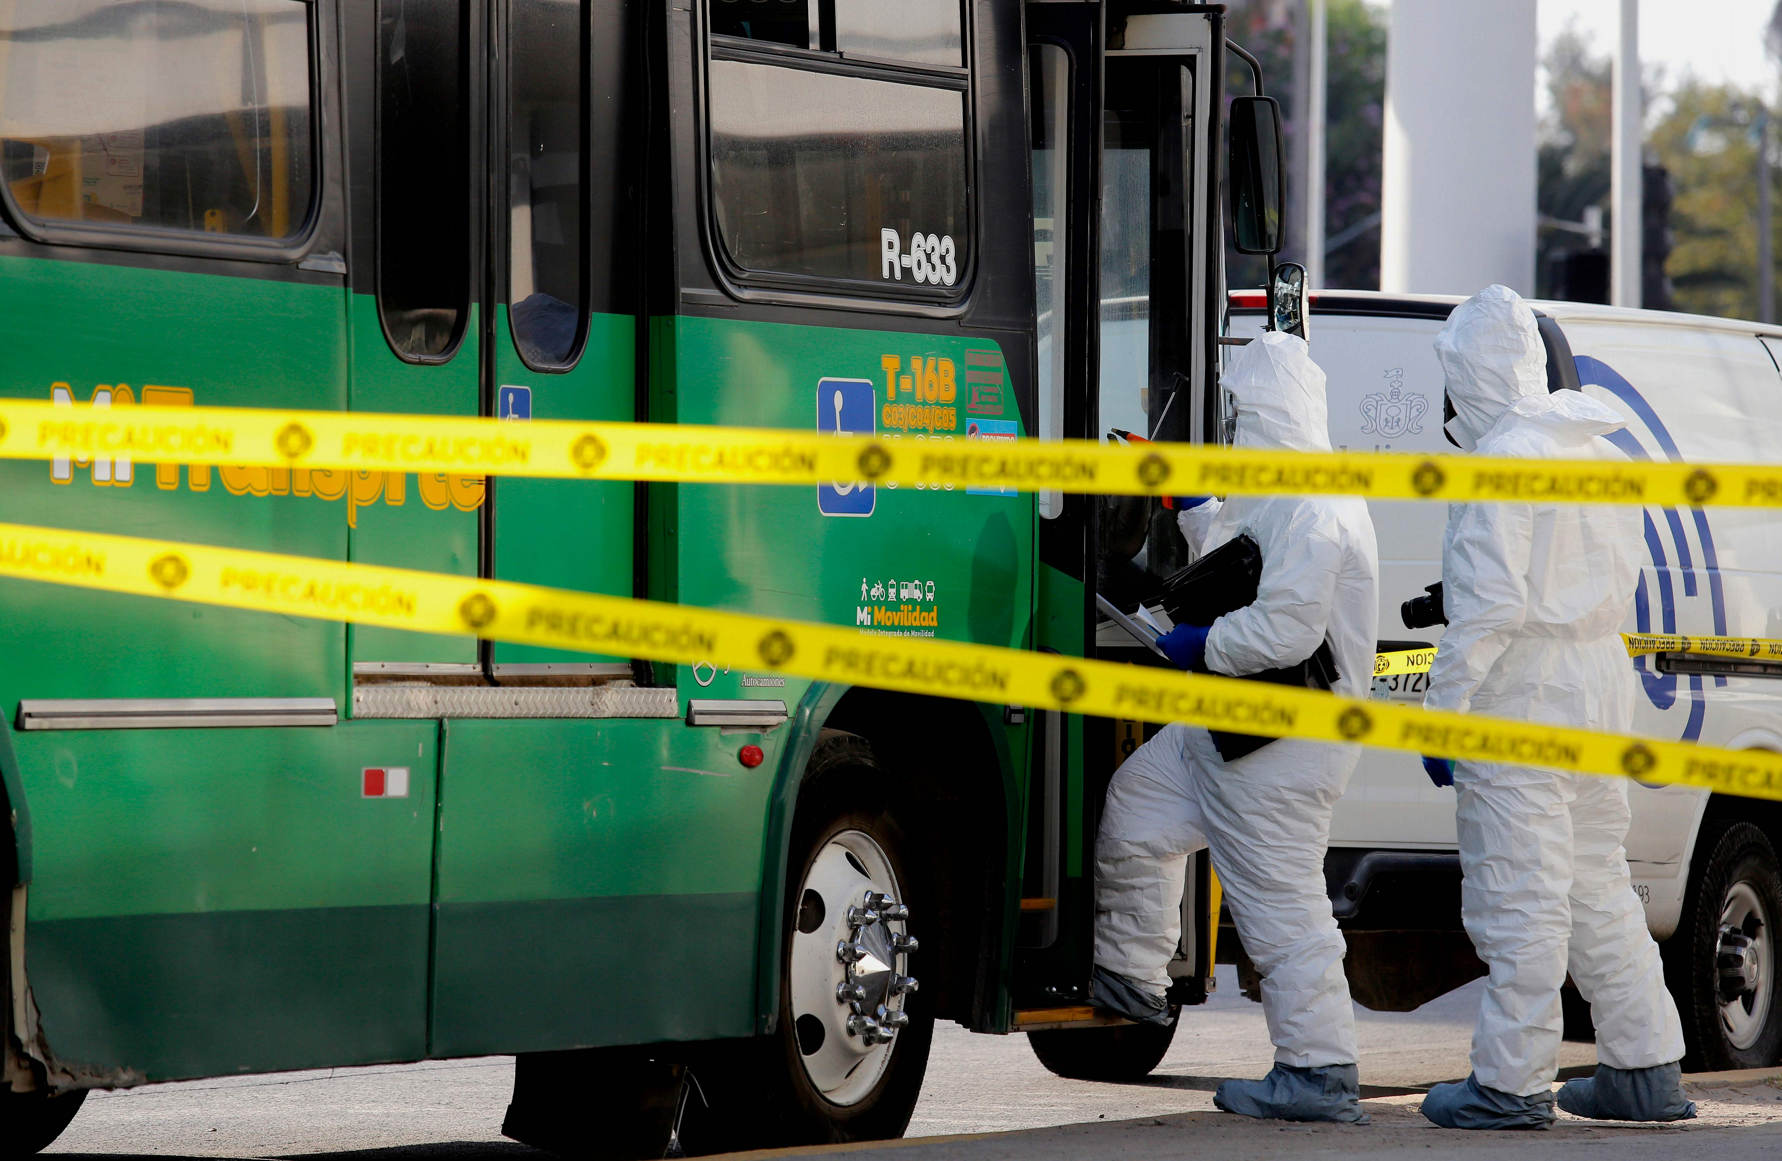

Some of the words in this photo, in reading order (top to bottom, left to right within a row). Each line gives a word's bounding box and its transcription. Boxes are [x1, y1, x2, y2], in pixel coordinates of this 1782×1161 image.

[881, 228, 956, 286] R-633
[881, 354, 956, 404] T-16B
[882, 403, 956, 434] C03/C04/C05
[635, 444, 820, 475] PRECAUCIÓN
[919, 452, 1099, 482] PRECAUCIÓN
[1196, 461, 1375, 491] PRECAUCIÓN
[1471, 469, 1648, 500] PRECAUCIÓN
[856, 606, 871, 625] Mi
[873, 604, 938, 627] Movilidad
[911, 629, 936, 638] Movilidad
[523, 604, 719, 656] PRECAUCIÓN
[822, 644, 1010, 692] PRECAUCIÓN
[1112, 682, 1300, 729] PRECAUCIÓN
[1402, 721, 1586, 765] PRECAUCIÓN
